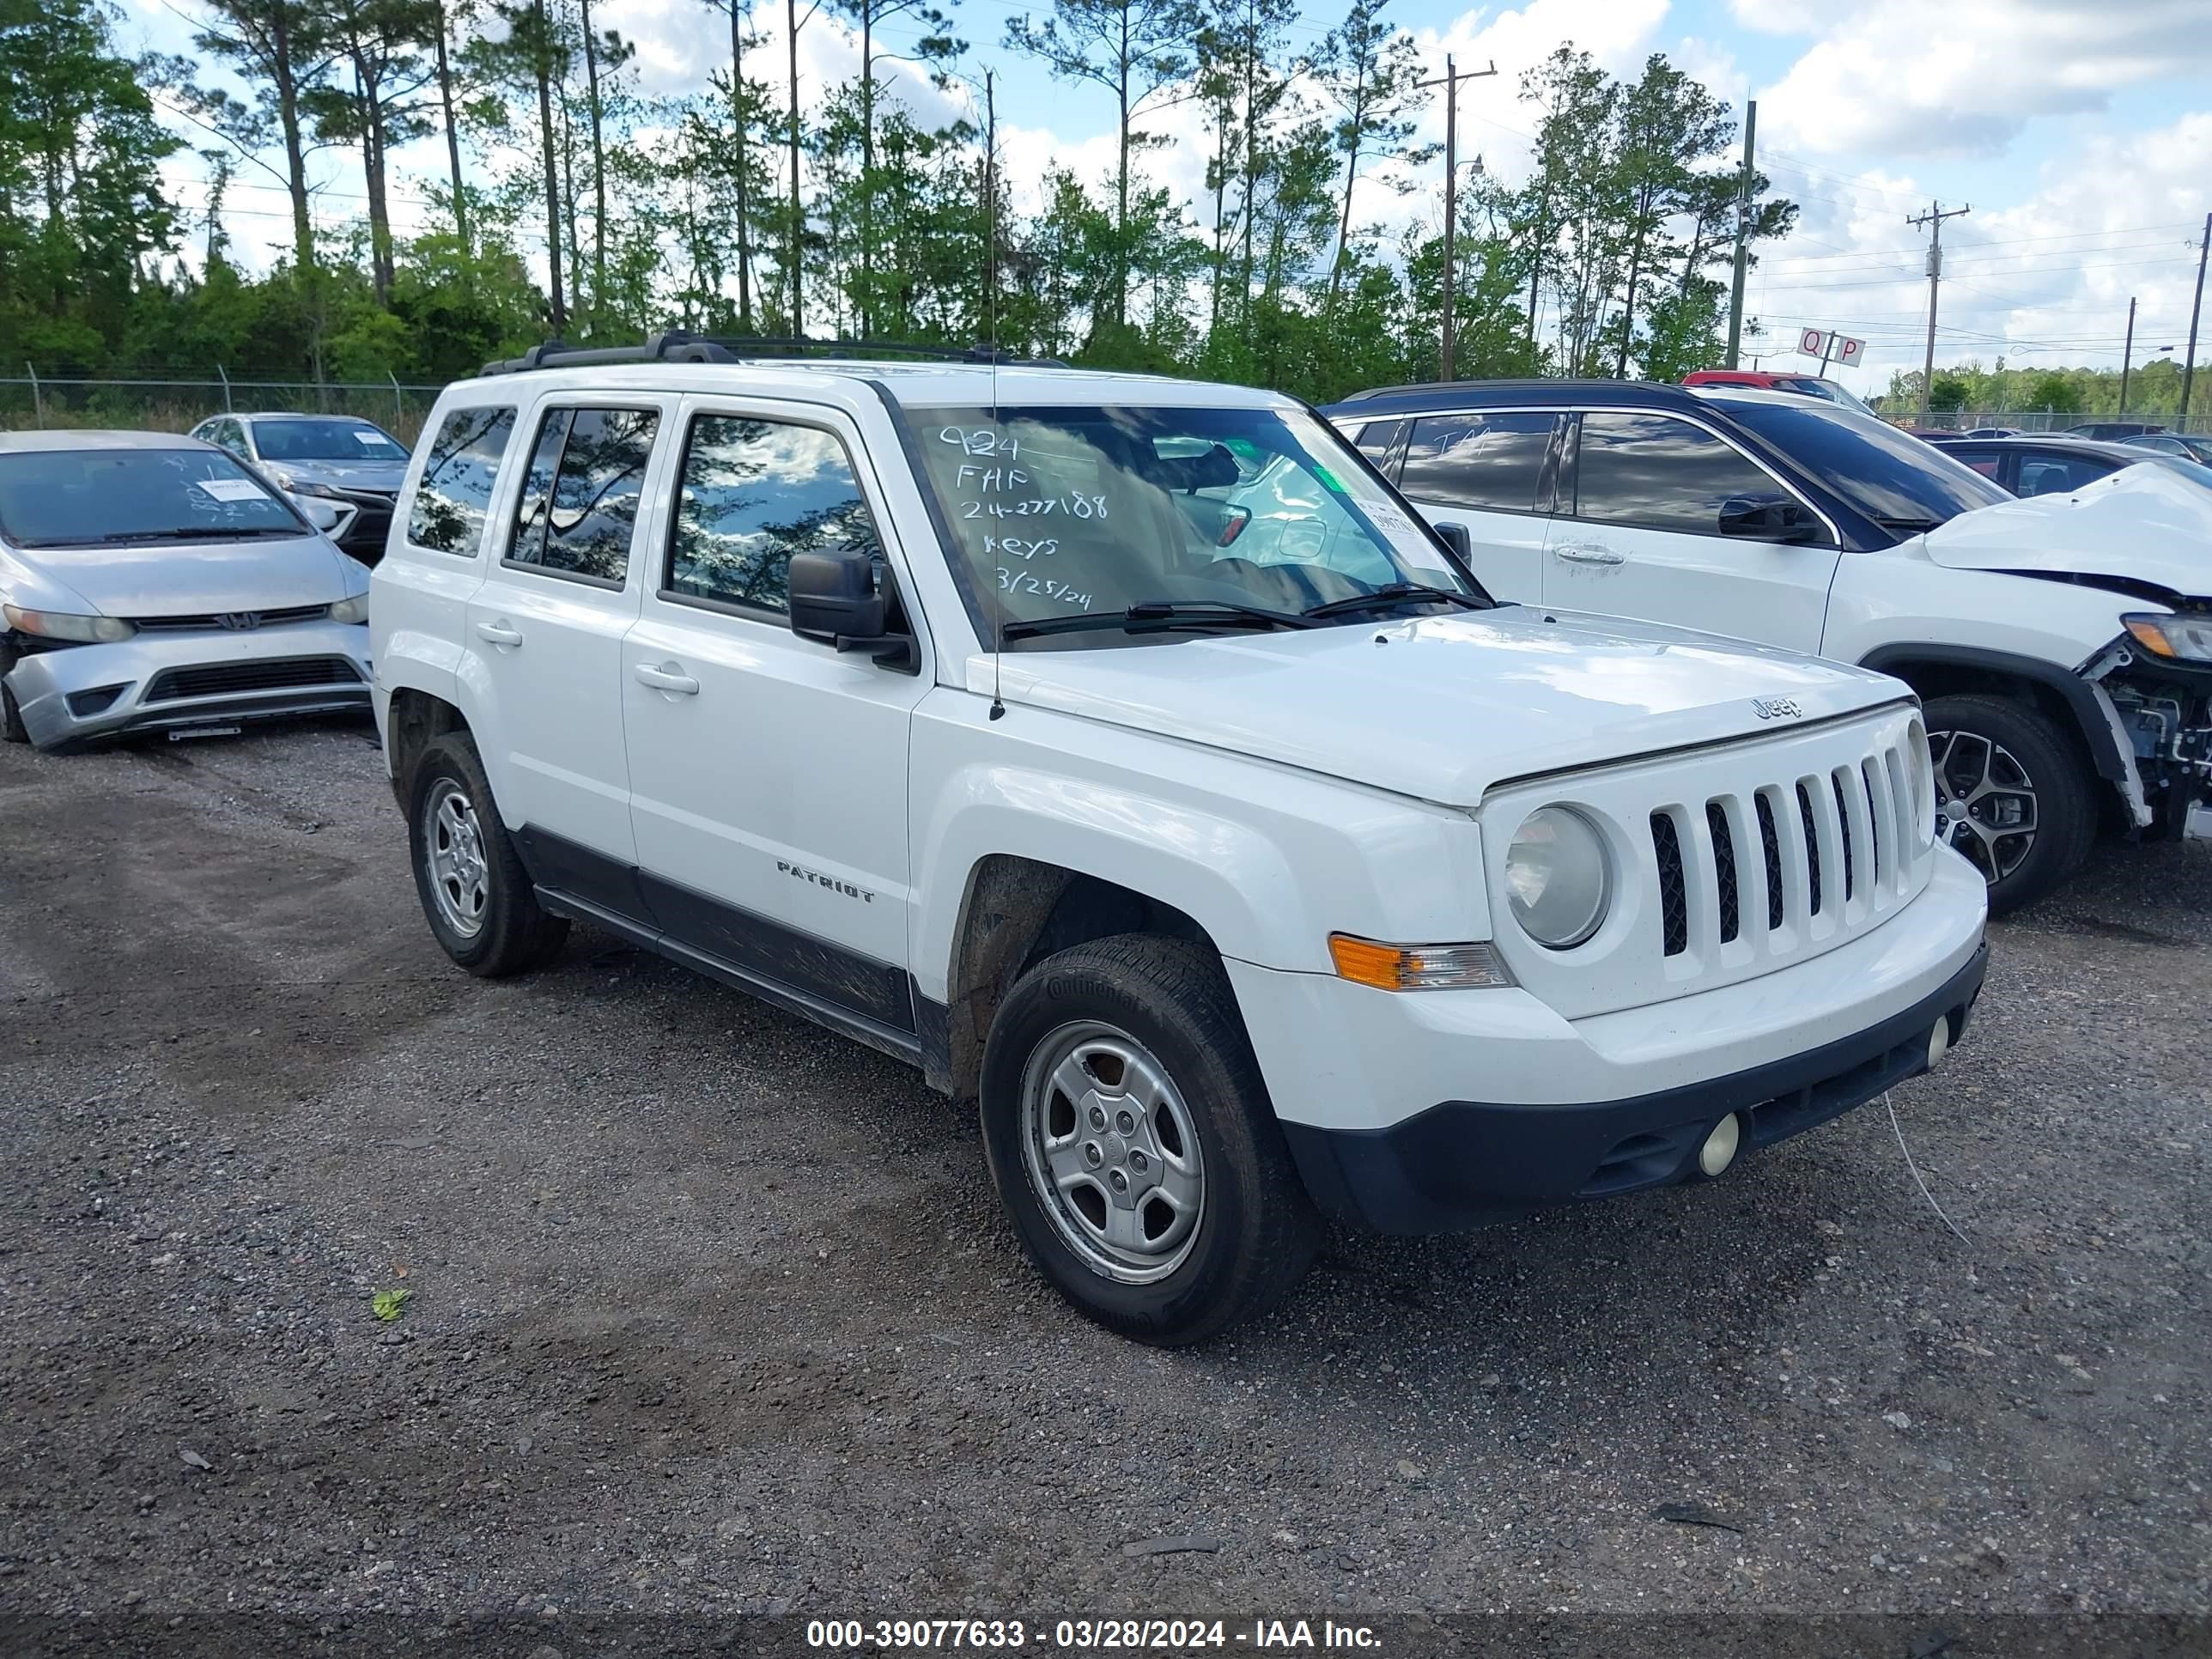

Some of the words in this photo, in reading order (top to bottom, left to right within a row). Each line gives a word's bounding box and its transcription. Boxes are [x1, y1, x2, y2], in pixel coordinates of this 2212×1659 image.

[1803, 331, 1820, 356] Q
[1841, 341, 1857, 362] P
[939, 426, 1018, 461] 924
[994, 567, 1093, 612] 3/25/24
[1750, 698, 1802, 720] Jeep
[776, 860, 875, 903] PATRIOT
